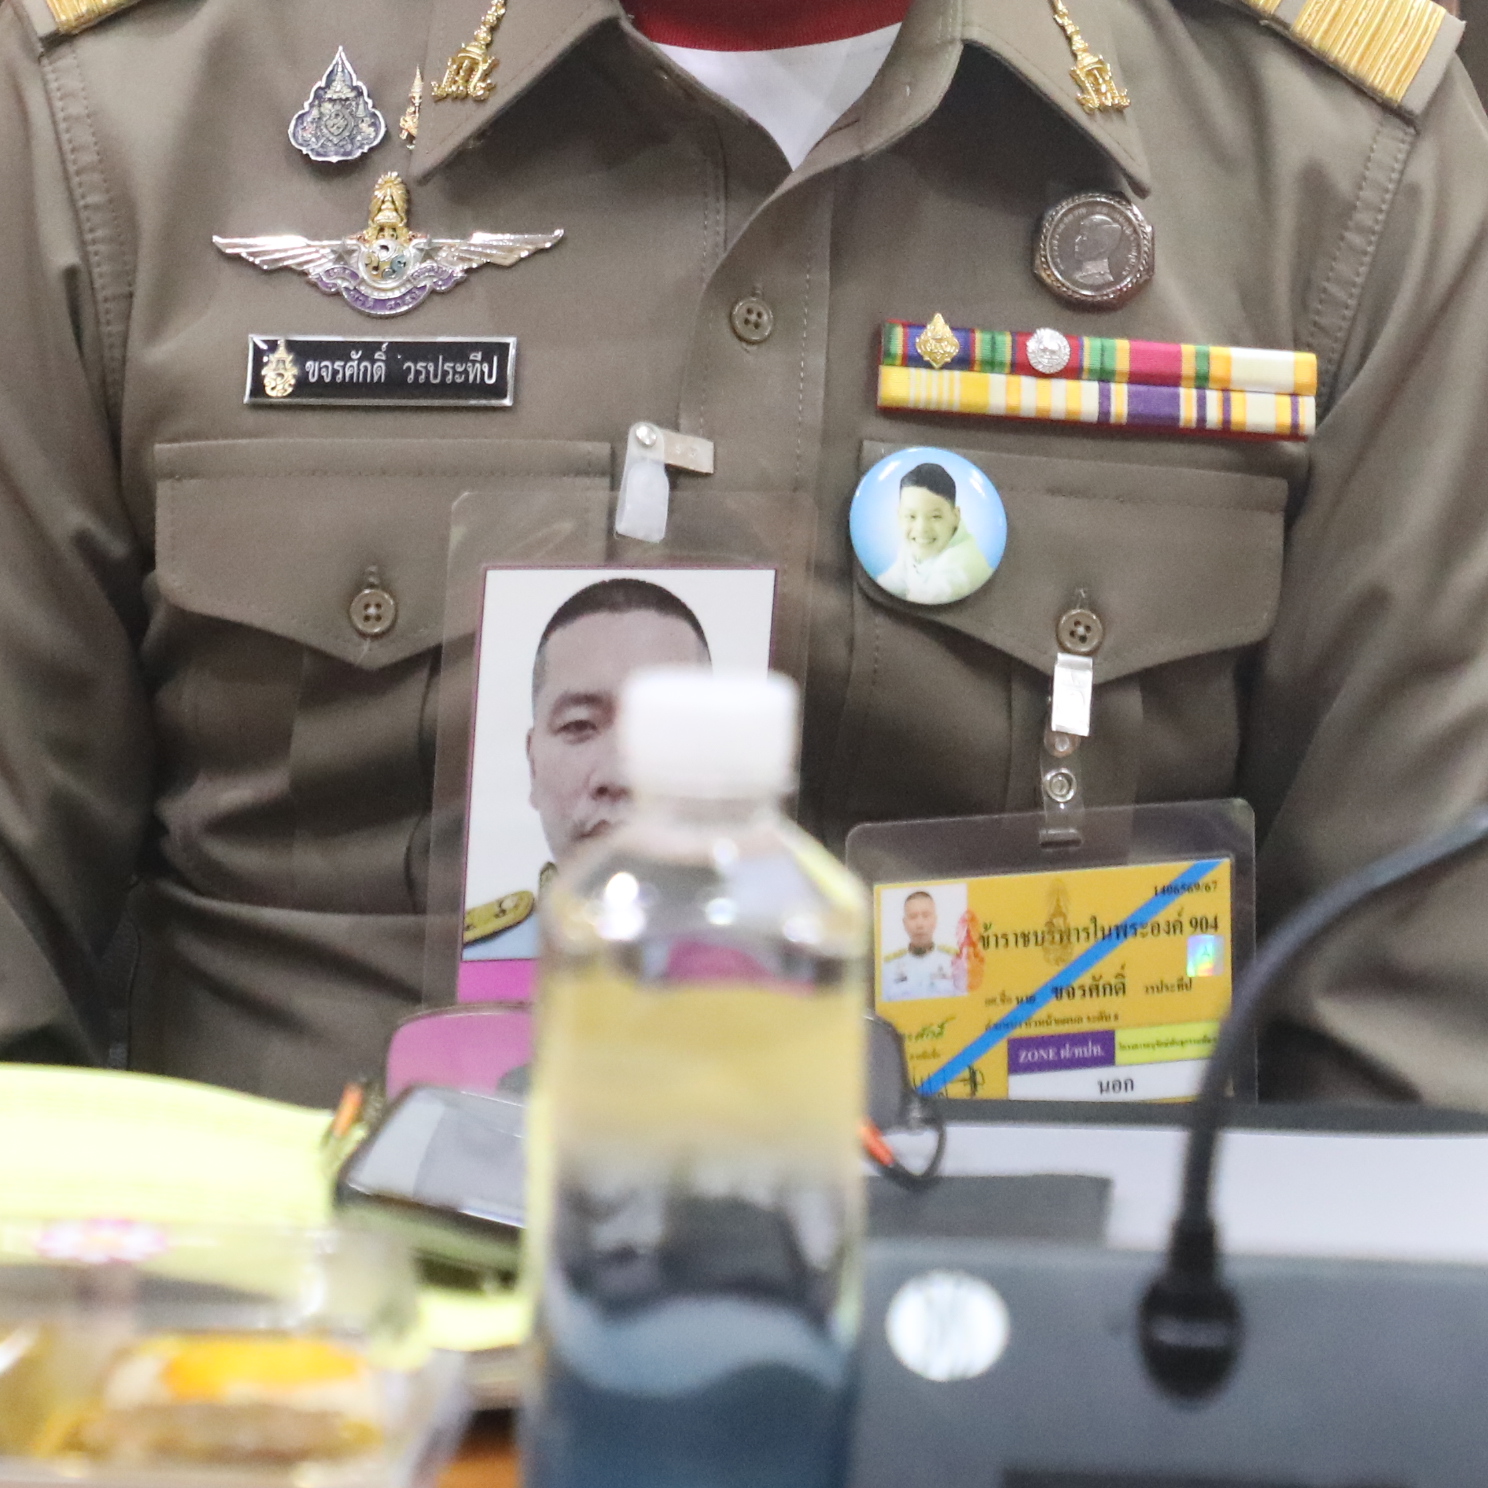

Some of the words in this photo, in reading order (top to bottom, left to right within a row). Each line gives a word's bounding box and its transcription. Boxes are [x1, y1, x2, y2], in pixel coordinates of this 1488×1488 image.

[305, 341, 388, 383] ขจรศักดิ์
[403, 351, 498, 384] วรประทีป
[1189, 914, 1219, 933] 904
[1052, 962, 1126, 1001] ขจรศักดิ์
[1019, 1047, 1057, 1064] ZONE
[1097, 1077, 1135, 1095] นอก
